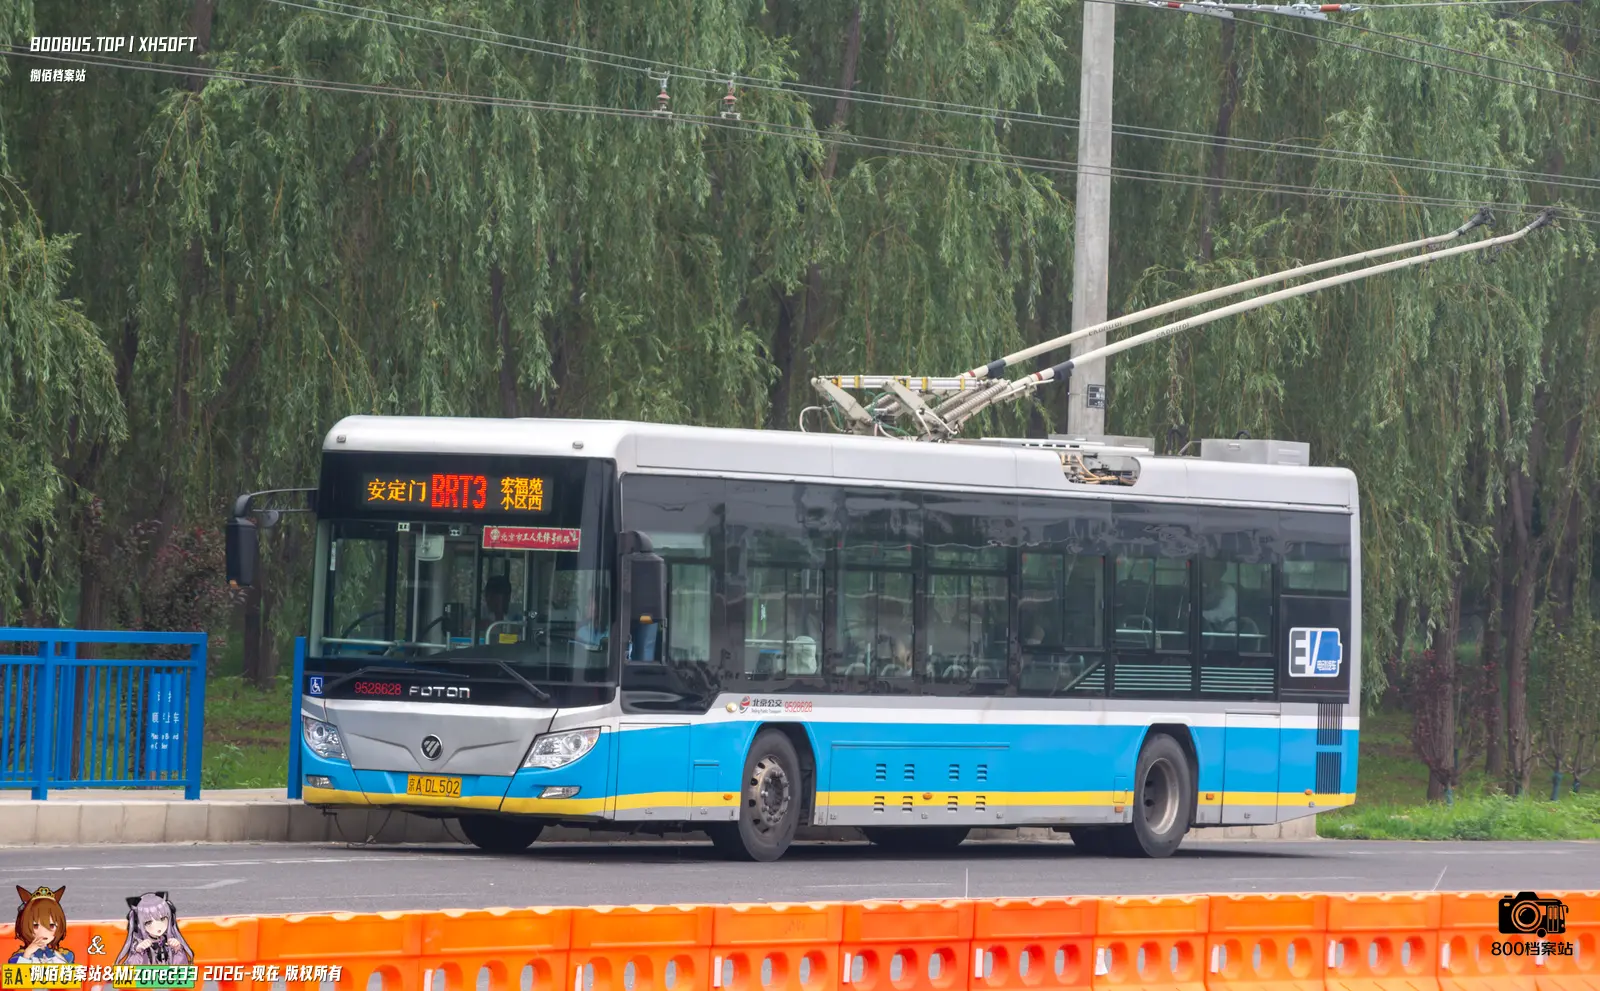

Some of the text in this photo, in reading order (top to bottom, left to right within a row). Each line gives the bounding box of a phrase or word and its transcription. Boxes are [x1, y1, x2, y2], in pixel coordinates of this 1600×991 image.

[367, 478, 427, 502] 安定门
[431, 474, 487, 509] BRT3
[500, 476, 544, 495] 宏福苑
[500, 494, 543, 511] 小区西
[355, 682, 402, 696] 9528628
[408, 686, 471, 699] FOTON
[752, 698, 783, 707] 北京公交
